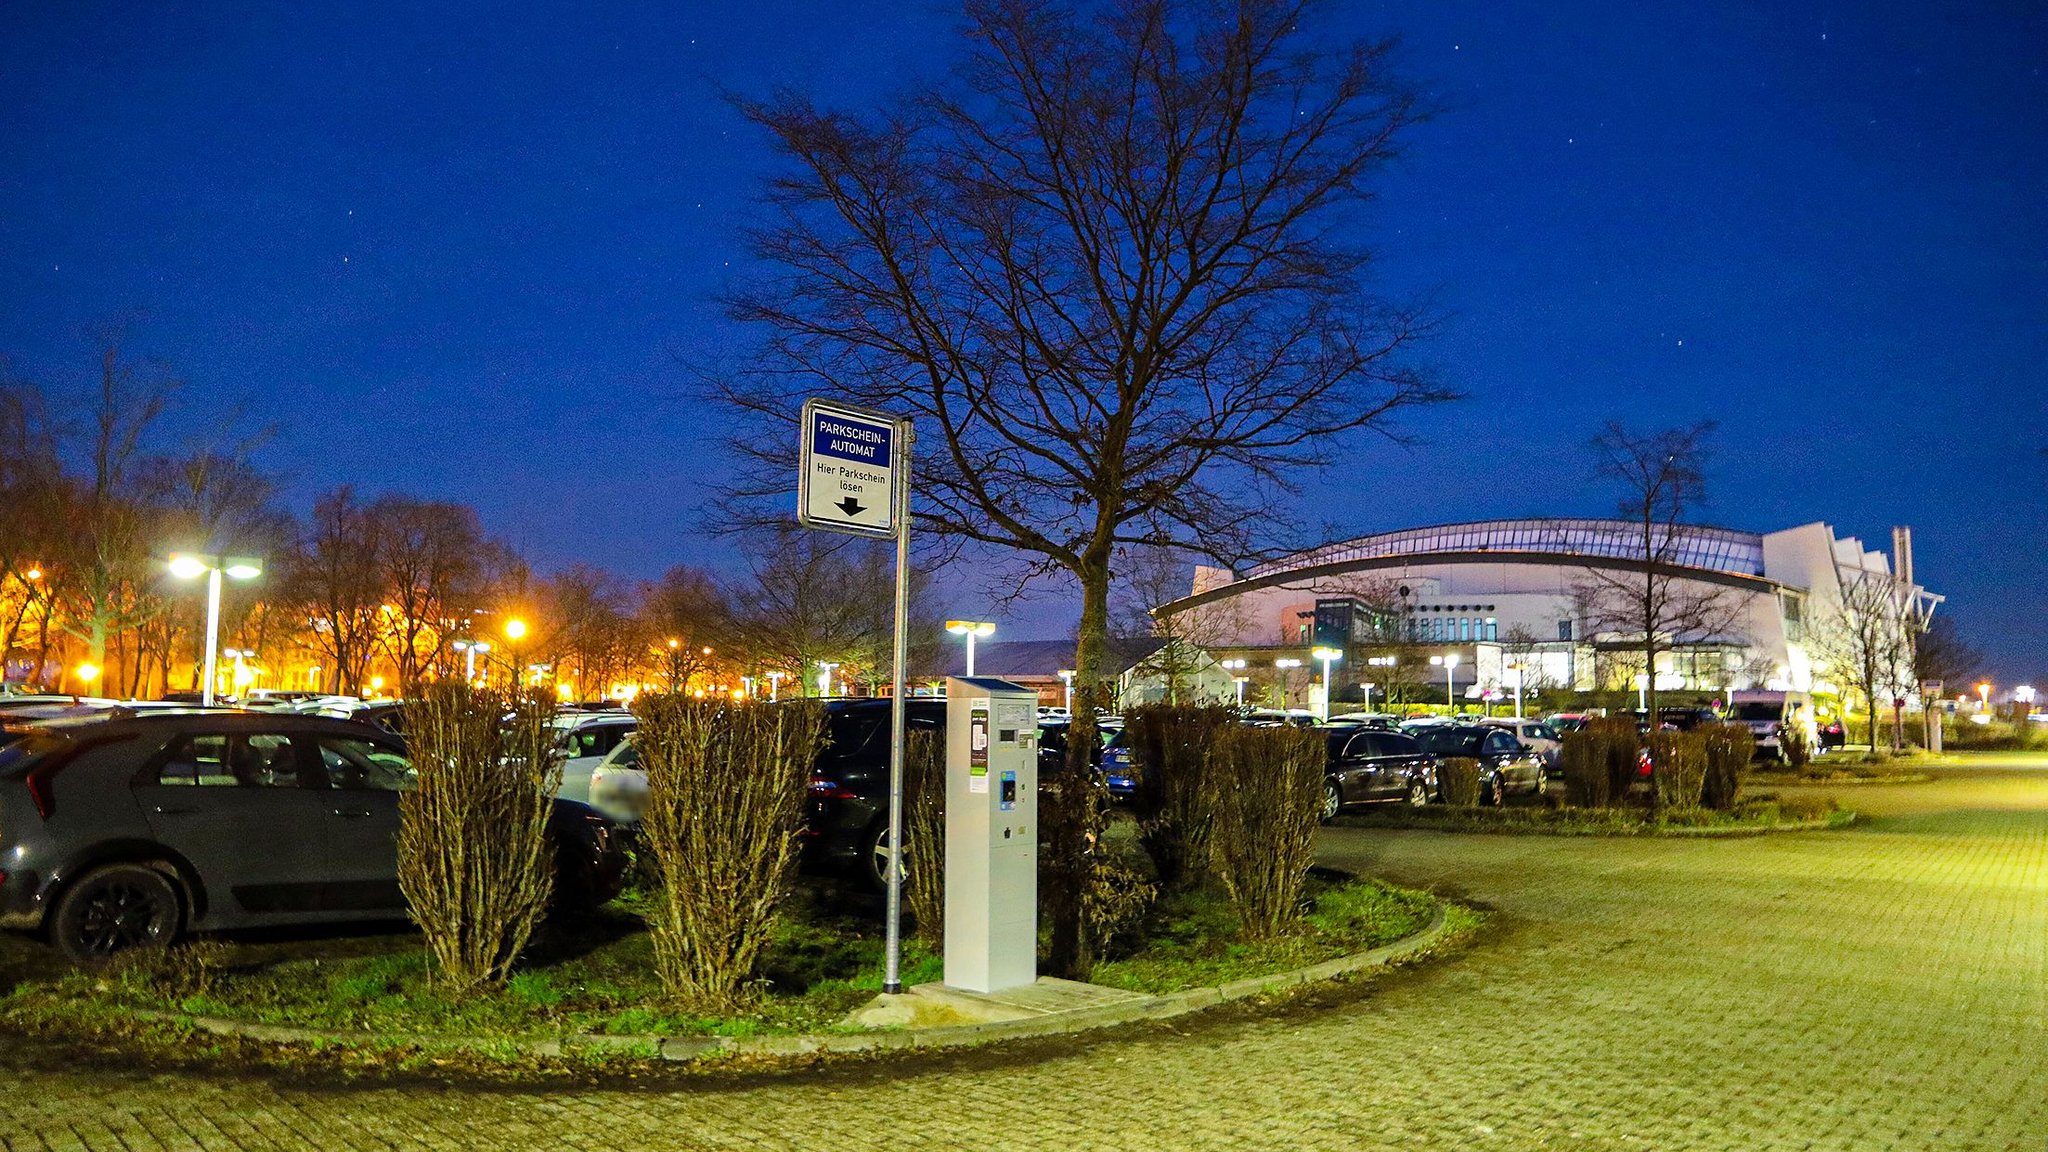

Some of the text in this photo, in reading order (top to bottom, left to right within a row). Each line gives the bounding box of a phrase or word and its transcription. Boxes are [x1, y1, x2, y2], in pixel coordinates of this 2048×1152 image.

[820, 421, 885, 444] PARKSCHEIN-
[830, 439, 875, 457] AUTOMAT
[817, 462, 885, 484] Hier Parkschein
[840, 480, 863, 493] lösen
